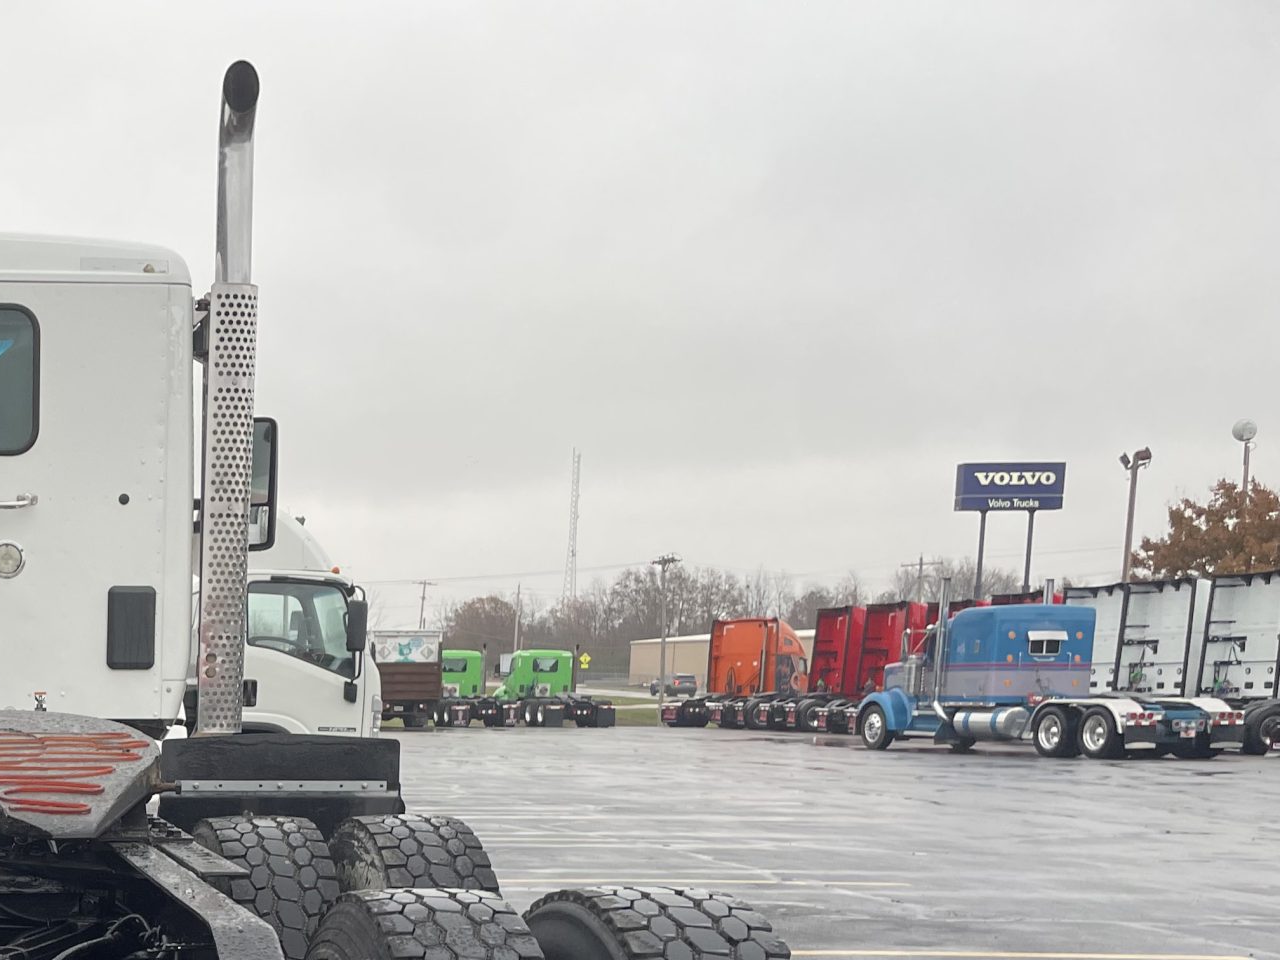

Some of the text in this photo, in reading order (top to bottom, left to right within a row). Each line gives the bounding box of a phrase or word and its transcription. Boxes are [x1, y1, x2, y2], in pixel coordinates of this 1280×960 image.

[974, 471, 1057, 486] VOLVO
[988, 498, 1039, 508] Volvo Trucks
